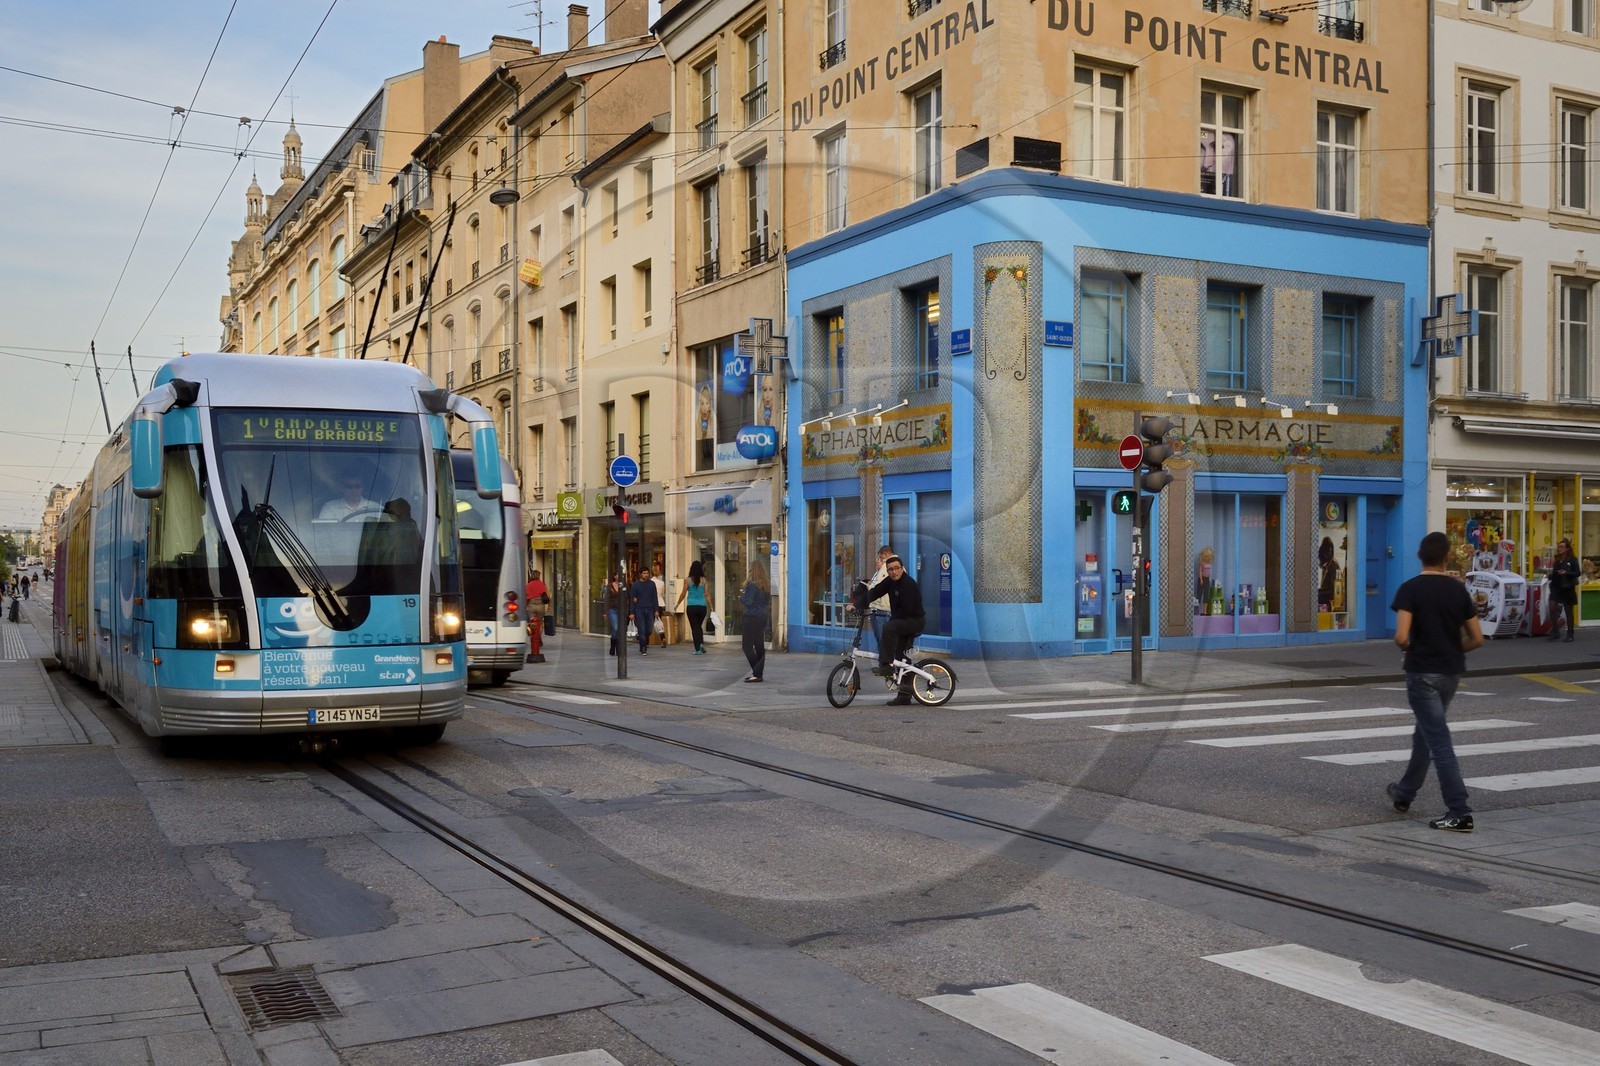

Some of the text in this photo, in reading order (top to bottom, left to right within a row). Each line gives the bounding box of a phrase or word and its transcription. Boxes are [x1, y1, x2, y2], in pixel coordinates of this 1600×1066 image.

[1048, 0, 1389, 94] DU POINT CENTRAL
[791, 0, 995, 132] DU POINT CENTRAL
[725, 357, 746, 376] ATOL
[243, 417, 399, 439] 1 VANDOEUVRE
[275, 428, 385, 442] CHU BRABOIS
[820, 419, 927, 451] PHARMACIE
[1141, 415, 1333, 444] HARMACIE
[740, 432, 774, 447] ATOL
[624, 492, 653, 506] OCHER
[402, 598, 416, 608] 19
[264, 651, 333, 662] Bienvenue
[264, 663, 366, 674] à votre nouveau
[379, 670, 405, 680] stan
[264, 675, 309, 686] réseau
[311, 673, 342, 685] Stan
[317, 710, 347, 722] 2145
[349, 709, 364, 721] YN
[364, 708, 379, 721] 54
